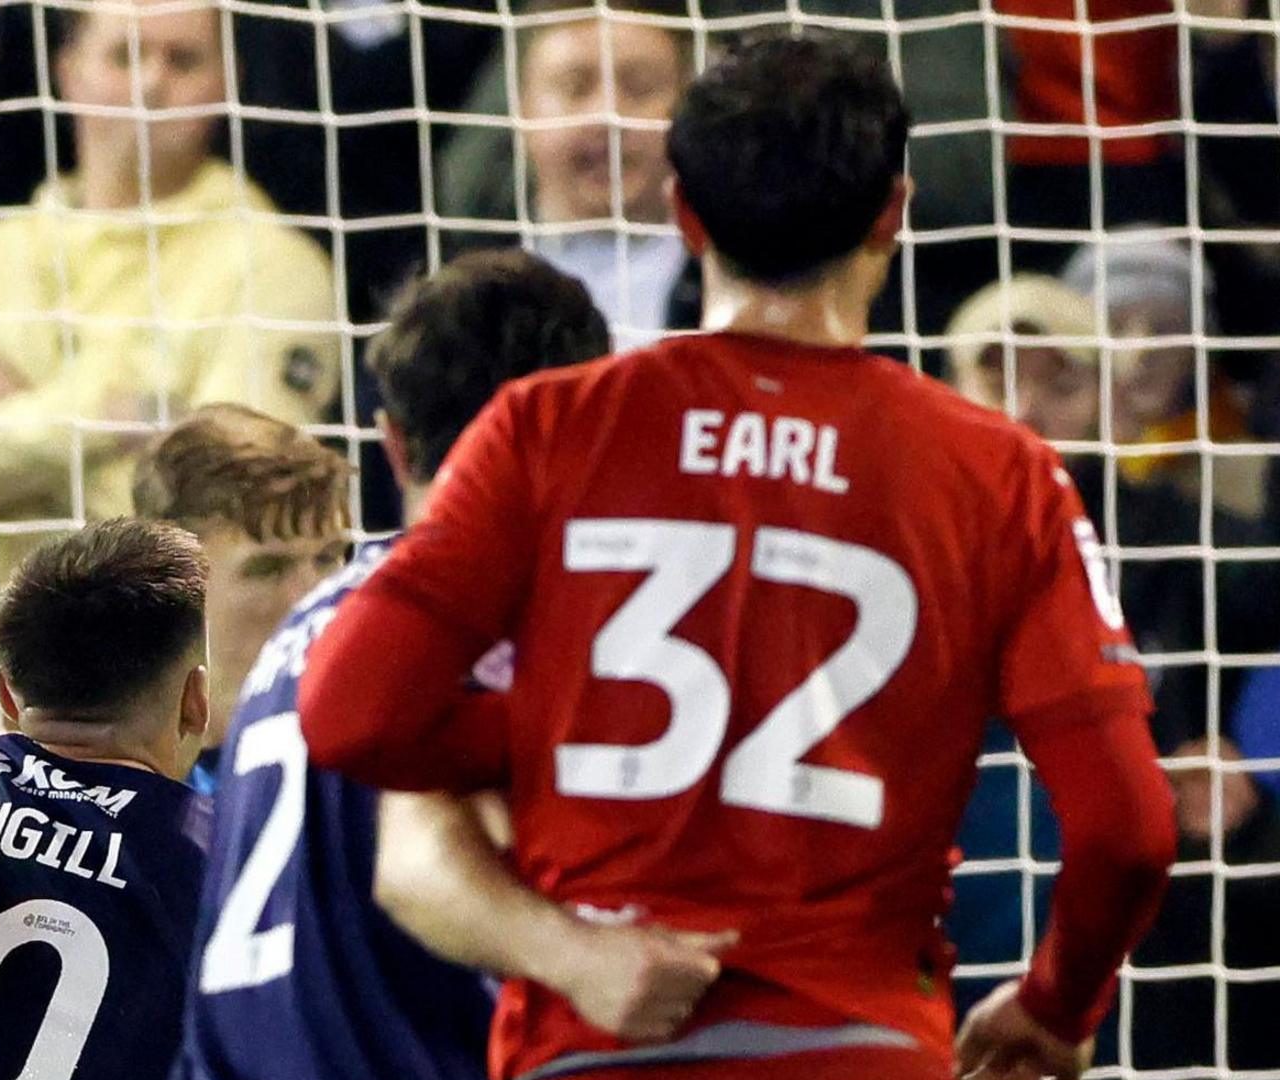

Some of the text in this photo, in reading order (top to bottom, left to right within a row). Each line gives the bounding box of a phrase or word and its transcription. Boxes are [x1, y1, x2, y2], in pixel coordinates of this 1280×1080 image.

[680, 409, 850, 494] EARL
[555, 518, 917, 829] 32
[200, 709, 308, 994] 2
